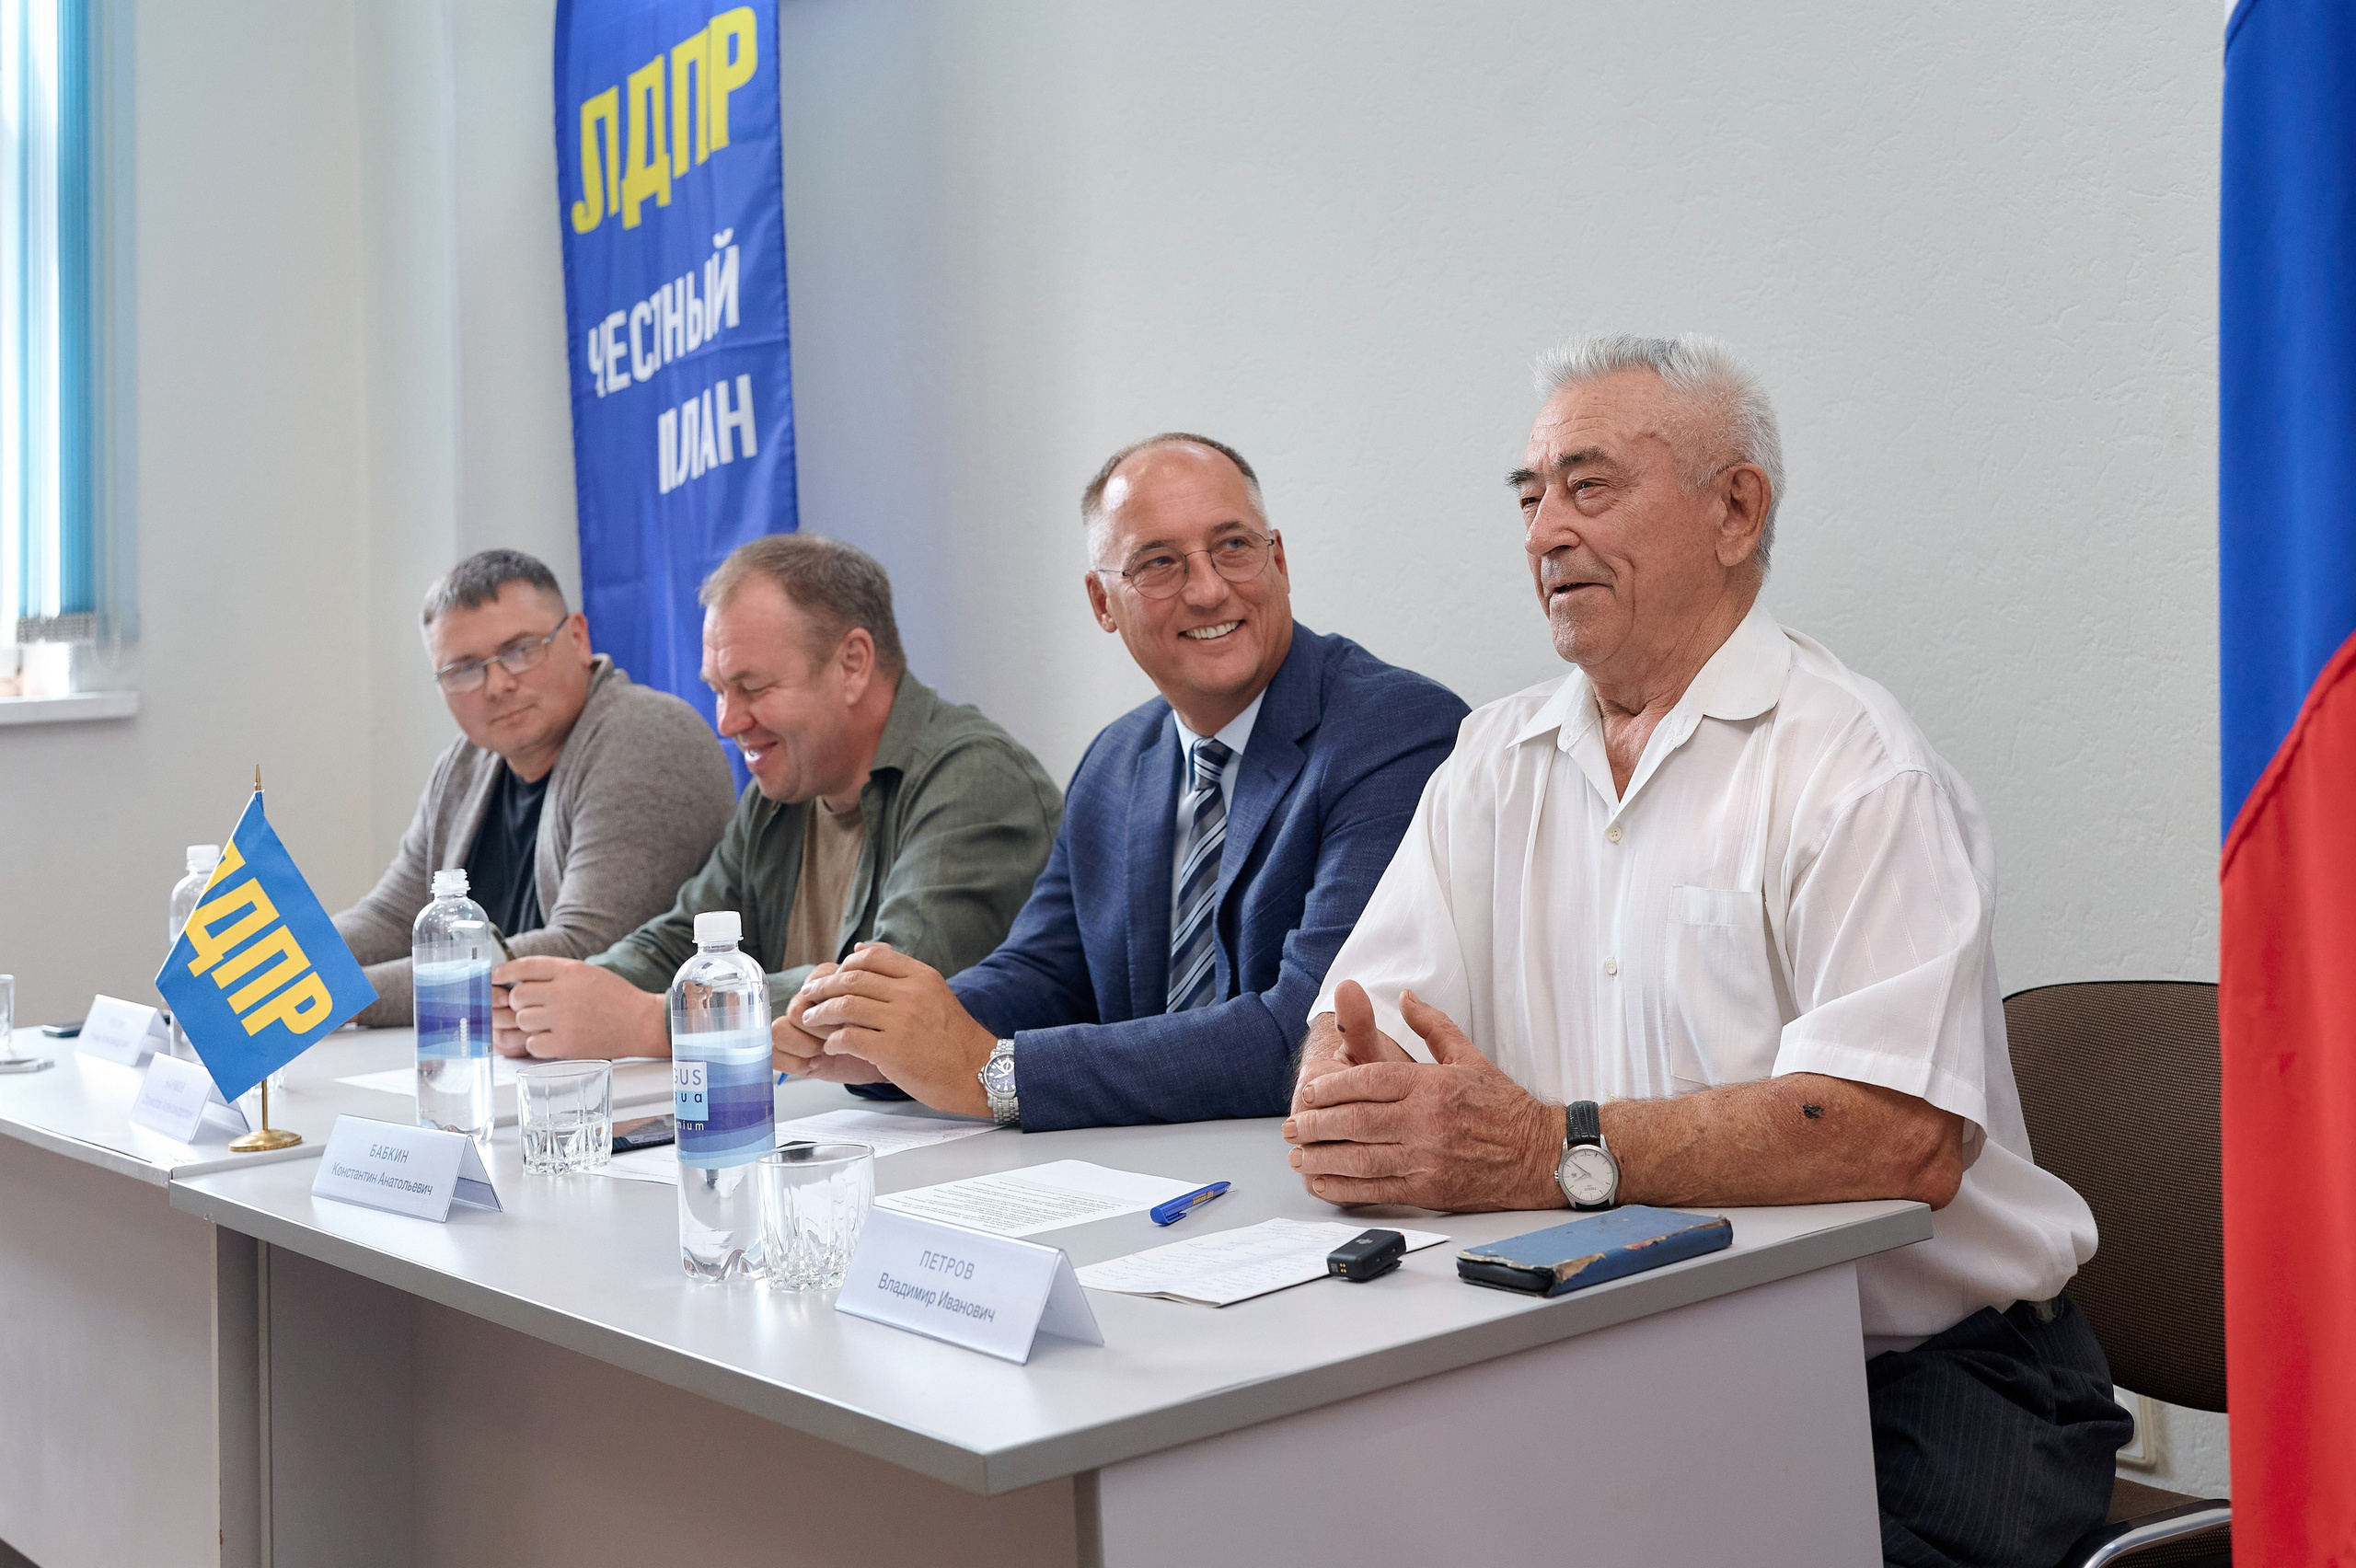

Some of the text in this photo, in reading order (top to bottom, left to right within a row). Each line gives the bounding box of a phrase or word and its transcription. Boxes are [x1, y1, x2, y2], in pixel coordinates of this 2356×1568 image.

[572, 6, 757, 234] ЛДПР
[588, 227, 740, 398] ЧЕСТНЫЙ
[657, 374, 757, 495] ПЛАН
[331, 1162, 433, 1196] Константин Анатольевич
[368, 1144, 410, 1164] БАБКИН
[919, 1250, 975, 1280] ПЕТРОВ
[878, 1272, 996, 1322] Владимир Иванович
